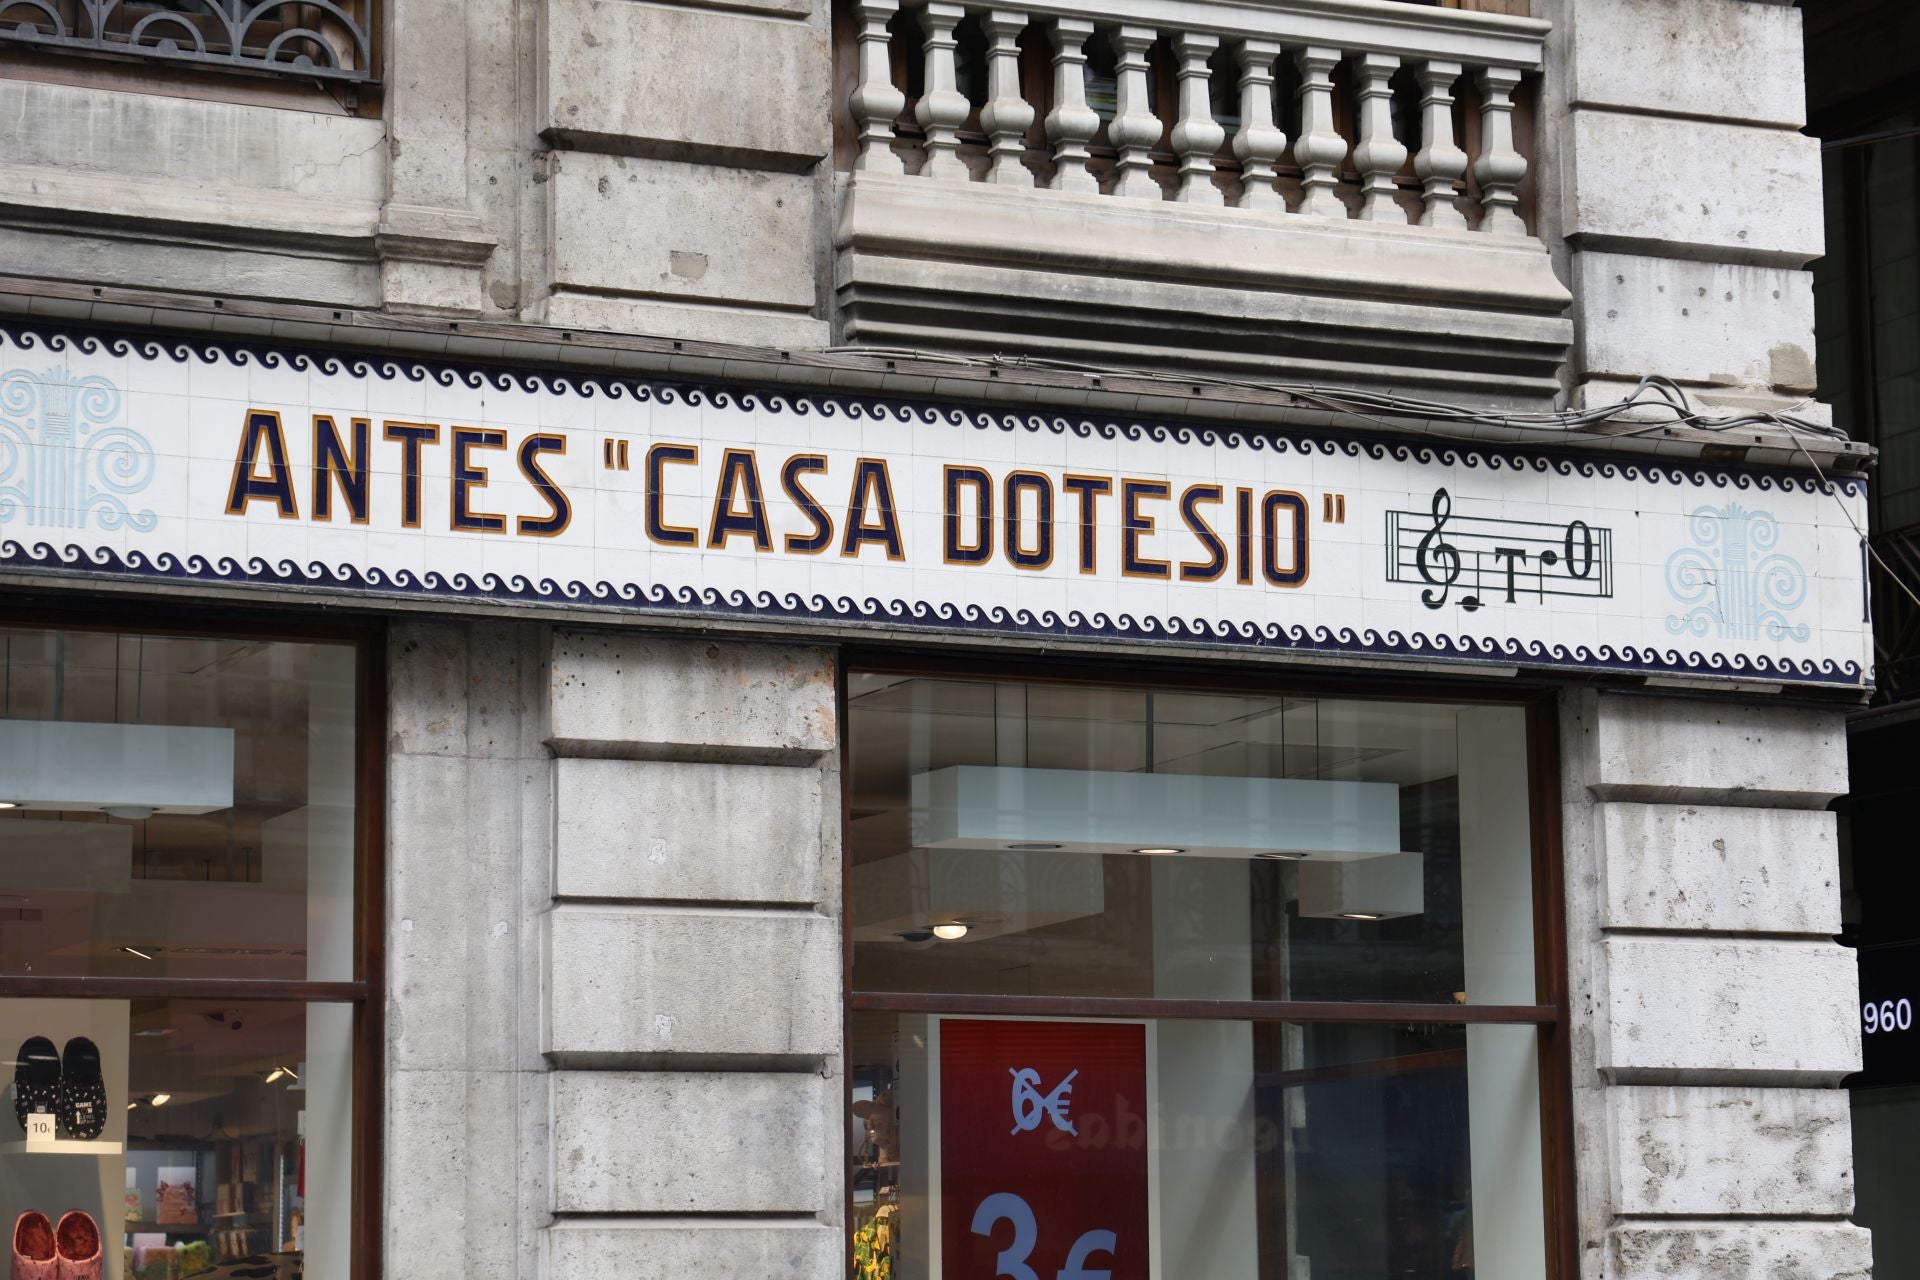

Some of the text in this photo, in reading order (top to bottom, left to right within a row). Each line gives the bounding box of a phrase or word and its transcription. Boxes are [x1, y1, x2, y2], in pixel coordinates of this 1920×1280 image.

[225, 408, 1346, 588] ANTES "CASA DOTESIO"
[1863, 998, 1912, 1034] 960
